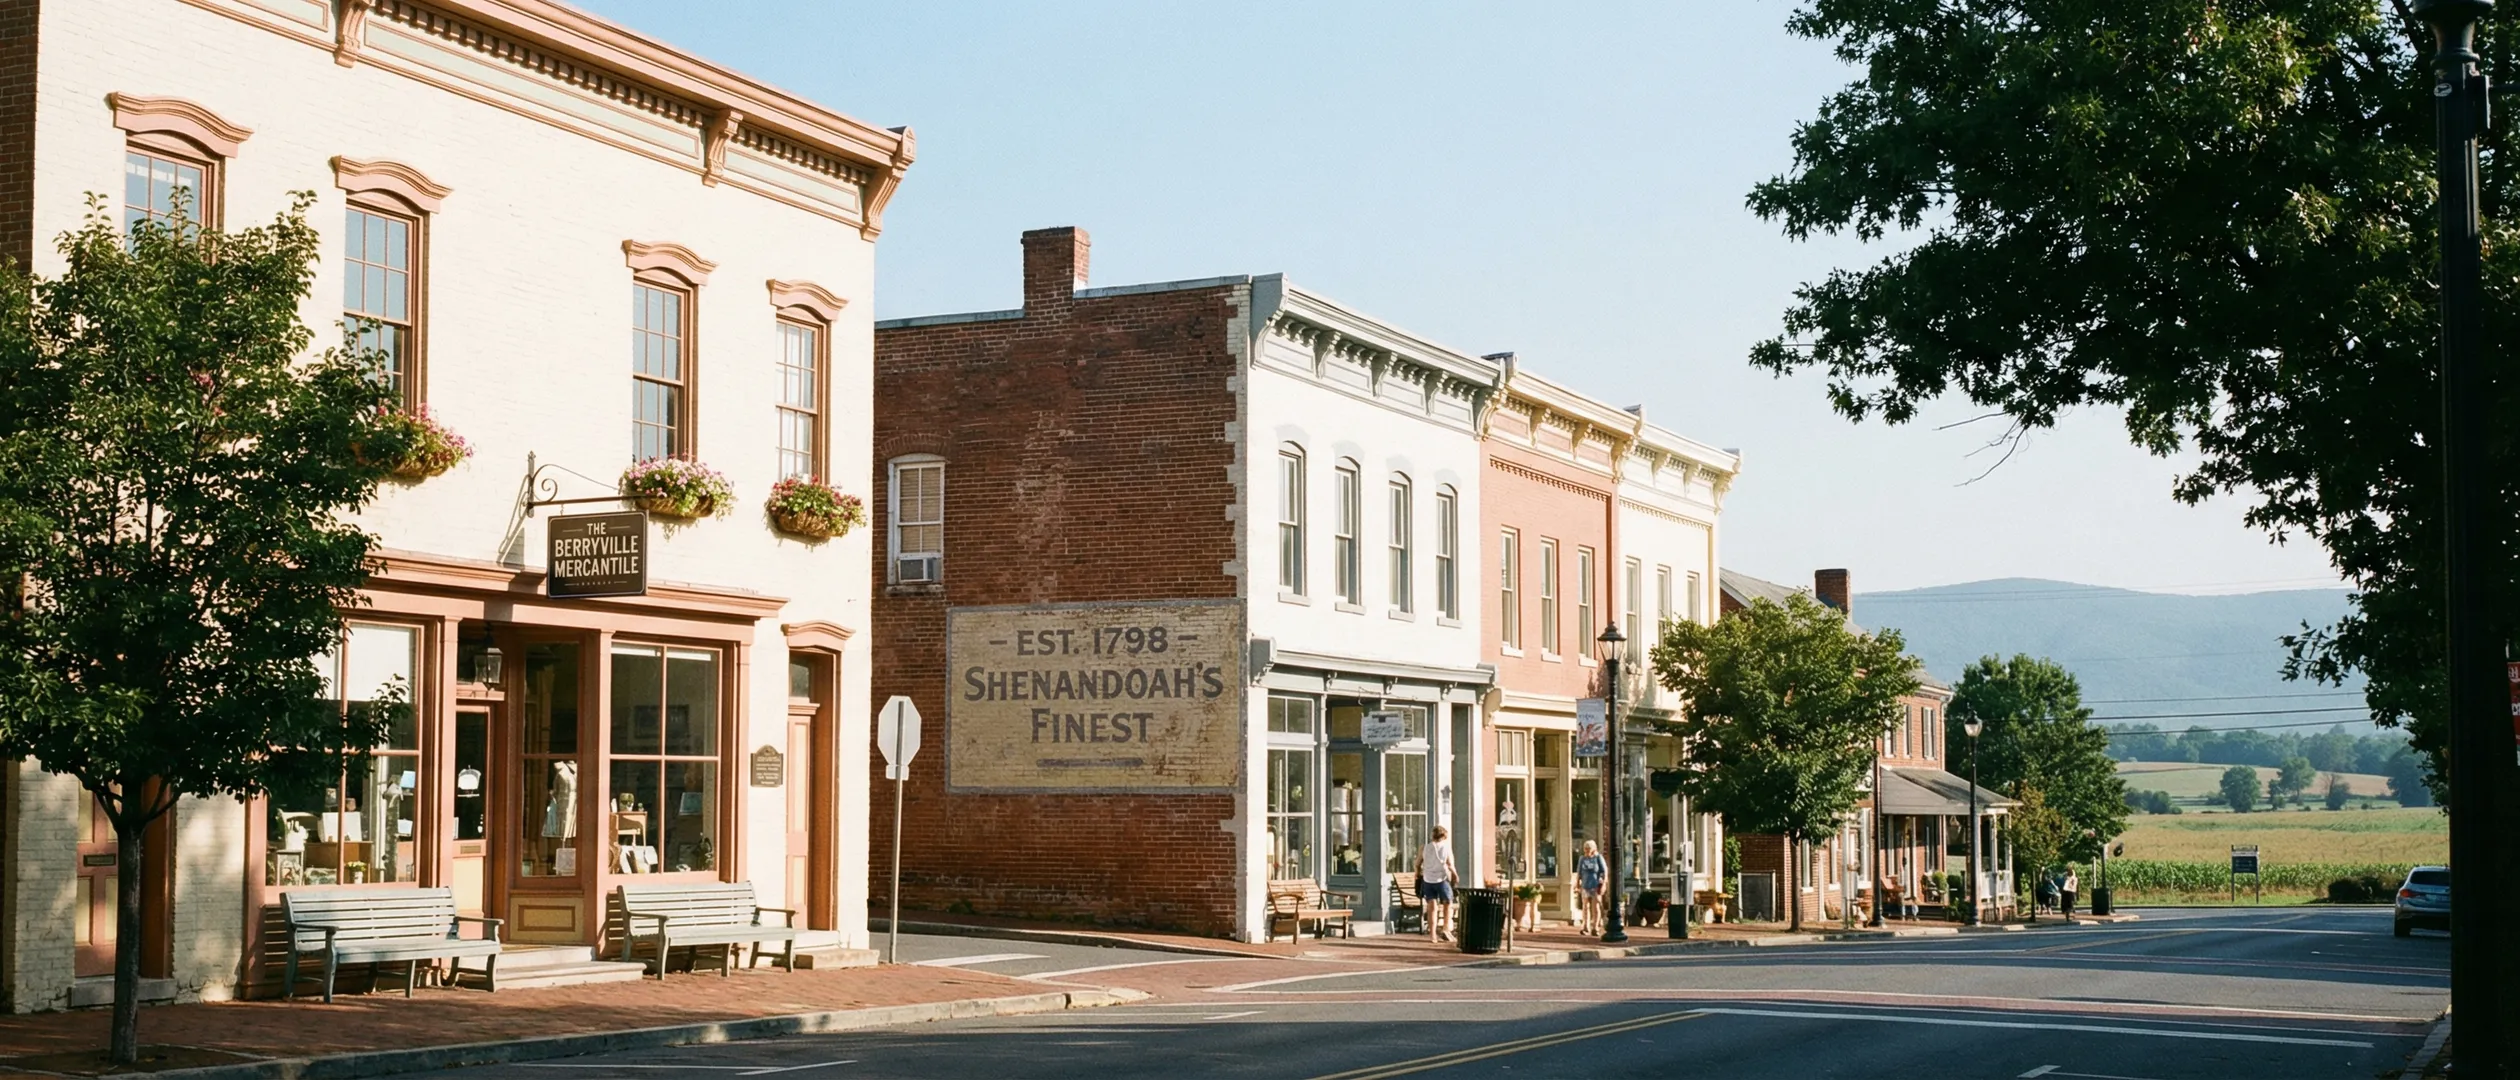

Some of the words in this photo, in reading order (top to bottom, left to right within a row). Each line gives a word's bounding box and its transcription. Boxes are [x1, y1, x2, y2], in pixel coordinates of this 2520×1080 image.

[587, 522, 607, 535] THE
[555, 535, 639, 557] BERRYVILLE
[554, 556, 639, 577] MERCANTILE
[1016, 629, 1080, 656] EST.
[1093, 627, 1169, 655] 1798
[964, 661, 1224, 701] SHENANDOAH'S
[1031, 708, 1154, 743] FINEST
